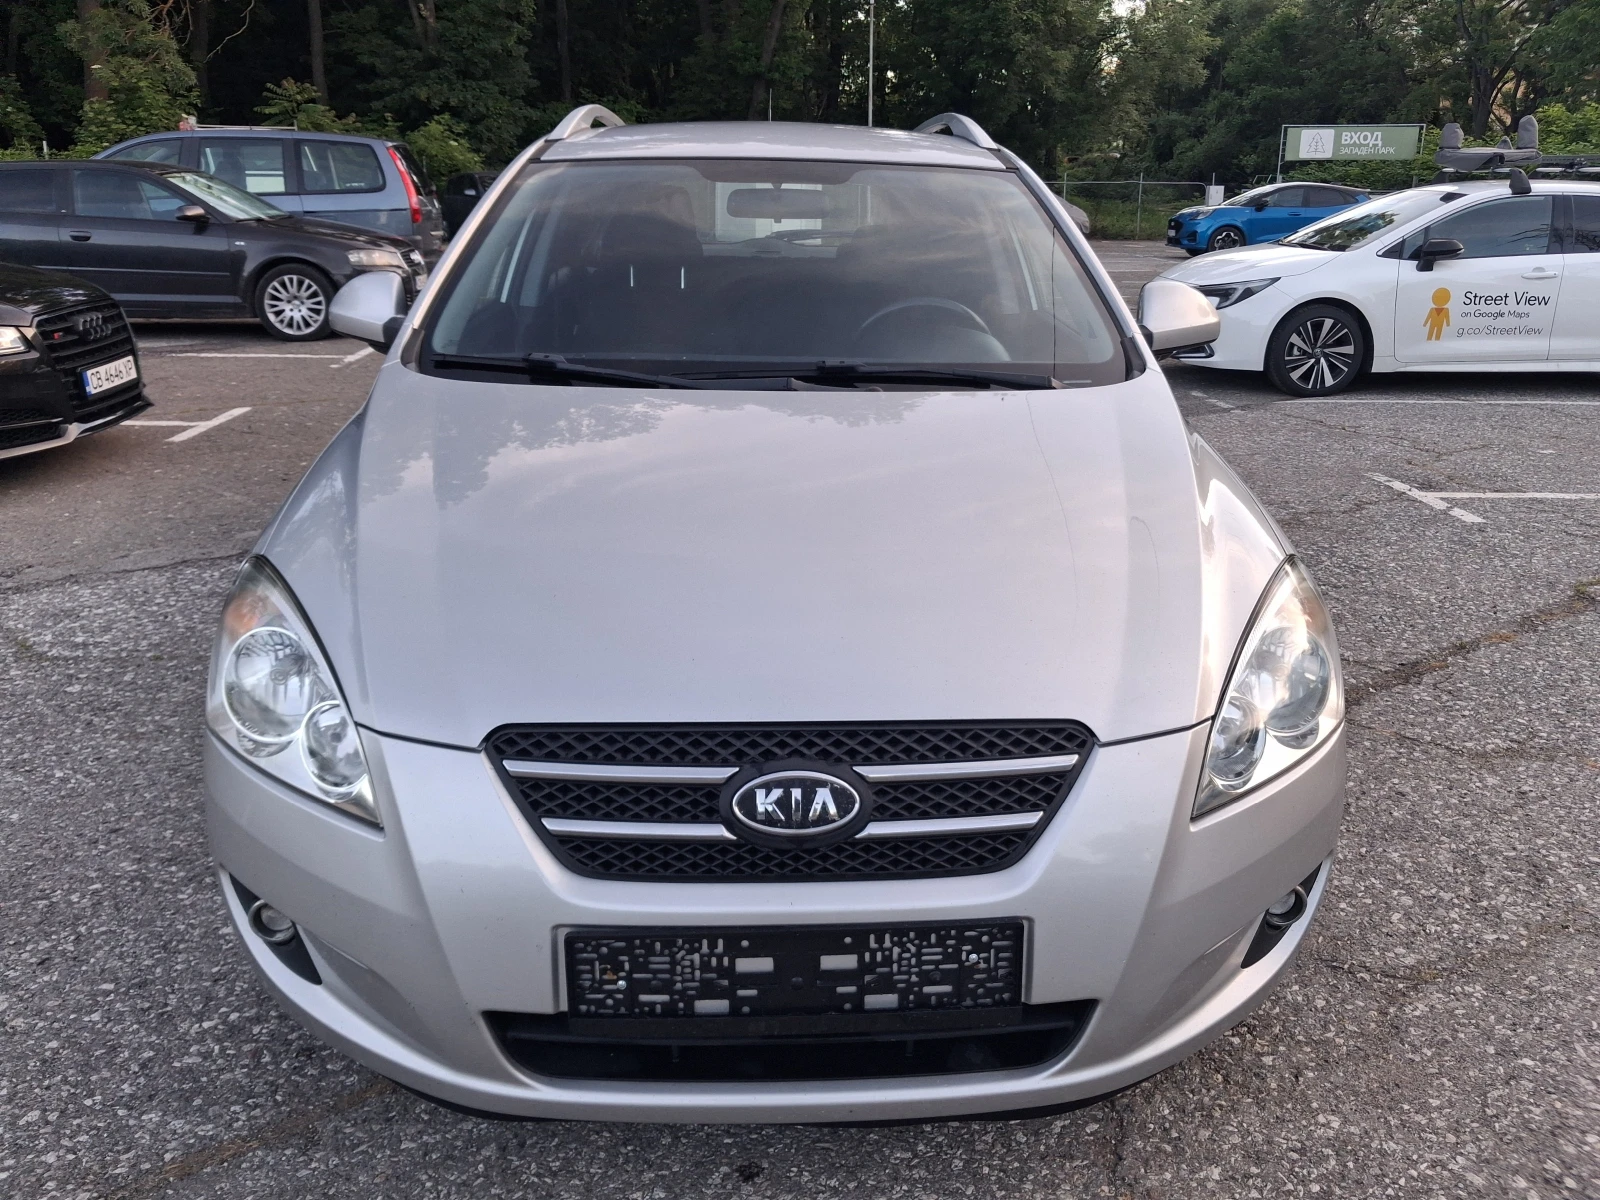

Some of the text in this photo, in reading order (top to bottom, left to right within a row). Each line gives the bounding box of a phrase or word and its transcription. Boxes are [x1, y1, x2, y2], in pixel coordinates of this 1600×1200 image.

[1341, 131, 1382, 147] ВХОД
[1339, 146, 1396, 155] ЗАПАДЕН ПАРК
[1462, 290, 1551, 306] Street View
[1473, 309, 1506, 320] Google
[1507, 310, 1530, 319] Maps
[1456, 325, 1544, 338] g.co/StreetView
[105, 363, 124, 385] 4646
[754, 787, 841, 822] KIA
